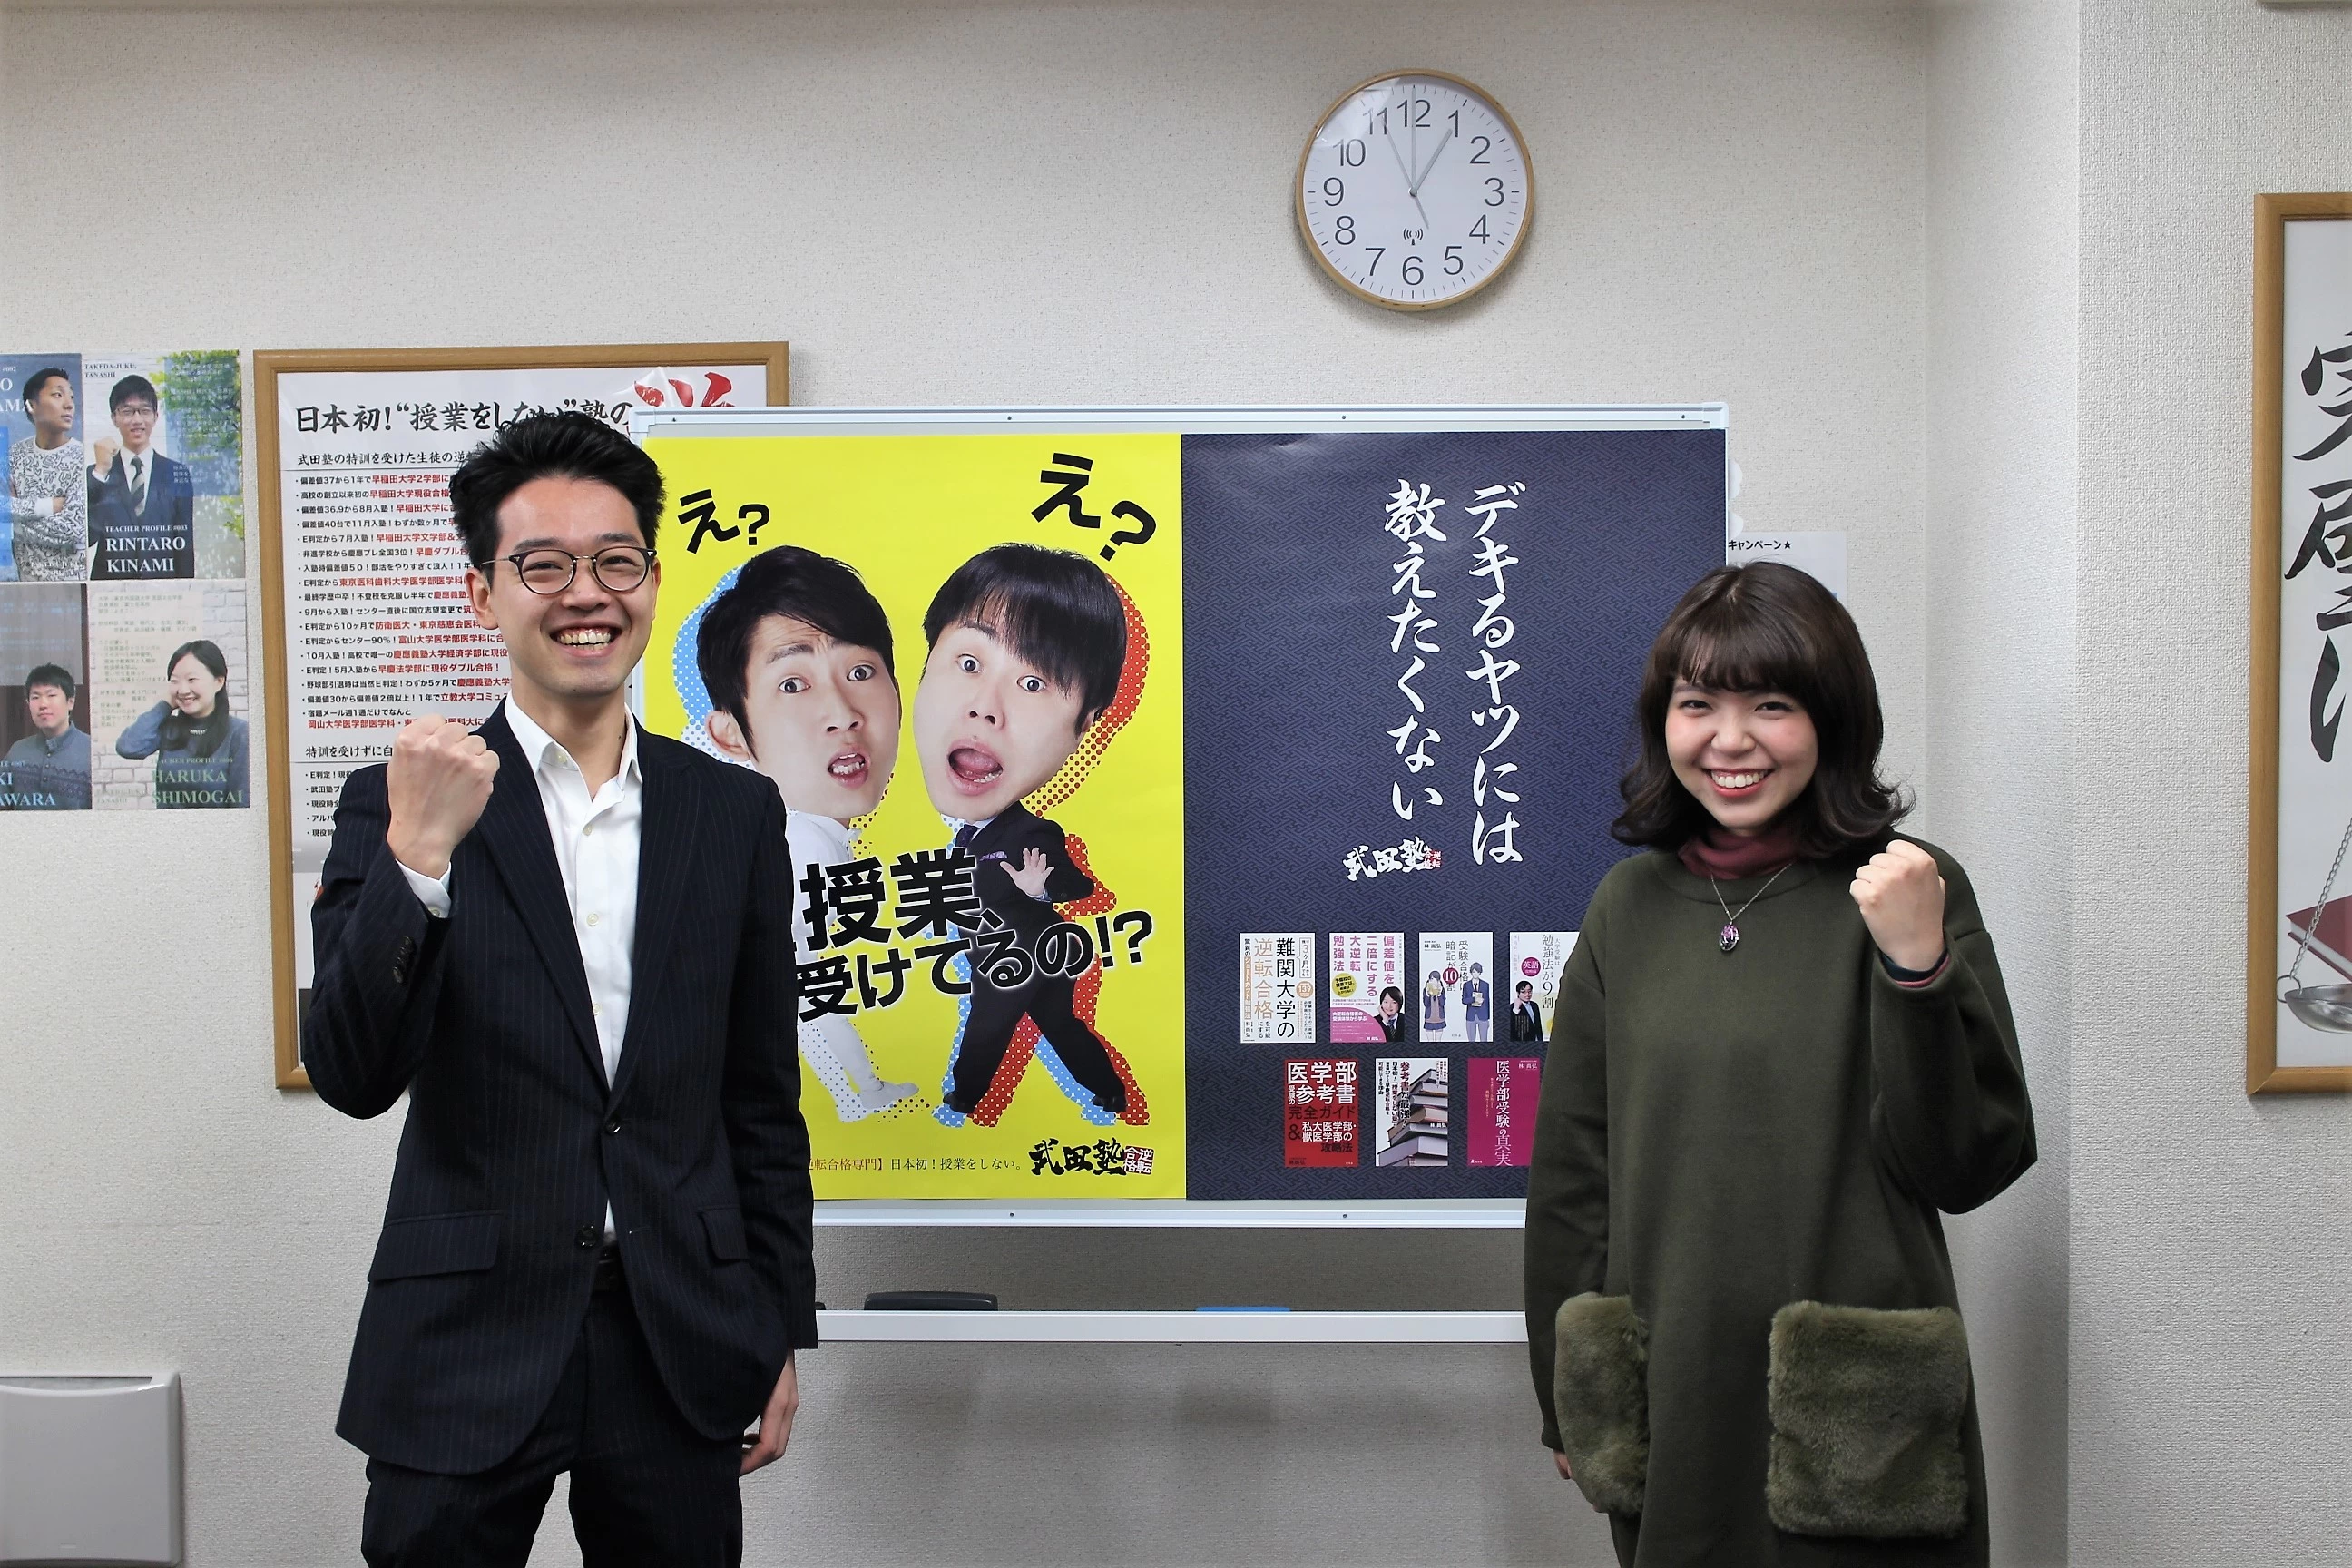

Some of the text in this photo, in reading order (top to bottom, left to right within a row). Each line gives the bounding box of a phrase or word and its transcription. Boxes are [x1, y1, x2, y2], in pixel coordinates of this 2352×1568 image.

[1362, 107, 1388, 135] 11
[1396, 99, 1431, 128] 12
[1448, 110, 1459, 137] 1
[1332, 138, 1366, 167] 10
[1469, 135, 1491, 164] 2
[1323, 177, 1345, 206] 9
[1484, 177, 1505, 206] 3
[1334, 215, 1356, 245] 8
[1468, 214, 1490, 244] 4
[1365, 247, 1386, 277] 7
[1402, 256, 1424, 285] 6
[1443, 245, 1464, 275] 5
[141, 524, 172, 533] PROFILE
[105, 536, 186, 552] RINTARO
[107, 558, 174, 573] KINAMI
[1384, 478, 1447, 820] 教えたくない
[1464, 480, 1526, 865] デキるヤツには
[152, 769, 228, 783] HARUKA
[152, 789, 243, 804] SHIMOGAI
[1333, 935, 1345, 972] 勉強法
[1349, 935, 1361, 972] 大逆転
[1367, 936, 1377, 997] 二倍にする
[1383, 935, 1395, 985] 偏差値を
[1276, 937, 1296, 1038] 難関大学の
[1288, 1061, 1357, 1084] 医学部
[1296, 1083, 1357, 1105] 参考書
[1289, 1106, 1356, 1120] 完全ガイド
[1494, 1060, 1513, 1167] 医学部受験の真実
